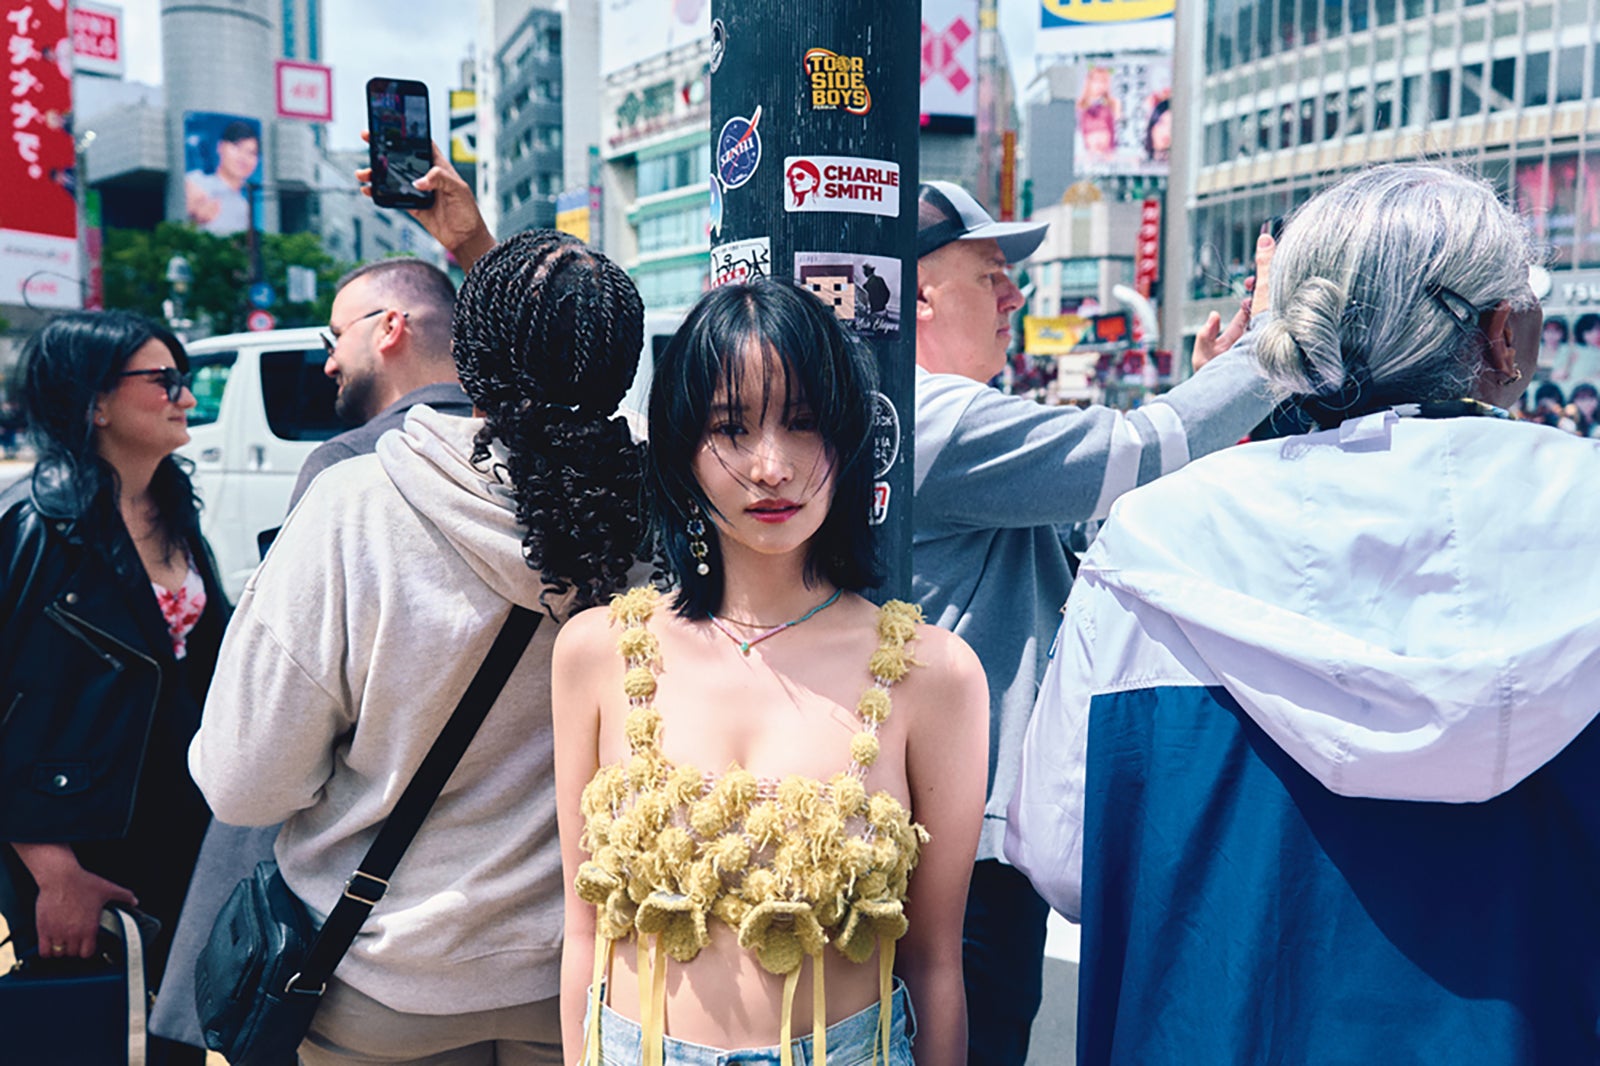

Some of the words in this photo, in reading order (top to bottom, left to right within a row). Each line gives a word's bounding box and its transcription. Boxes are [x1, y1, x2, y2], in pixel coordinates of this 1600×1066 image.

[811, 72, 865, 89] SIDE
[812, 89, 866, 106] BOYS
[823, 164, 899, 187] CHARLIE
[824, 182, 883, 202] SMITH
